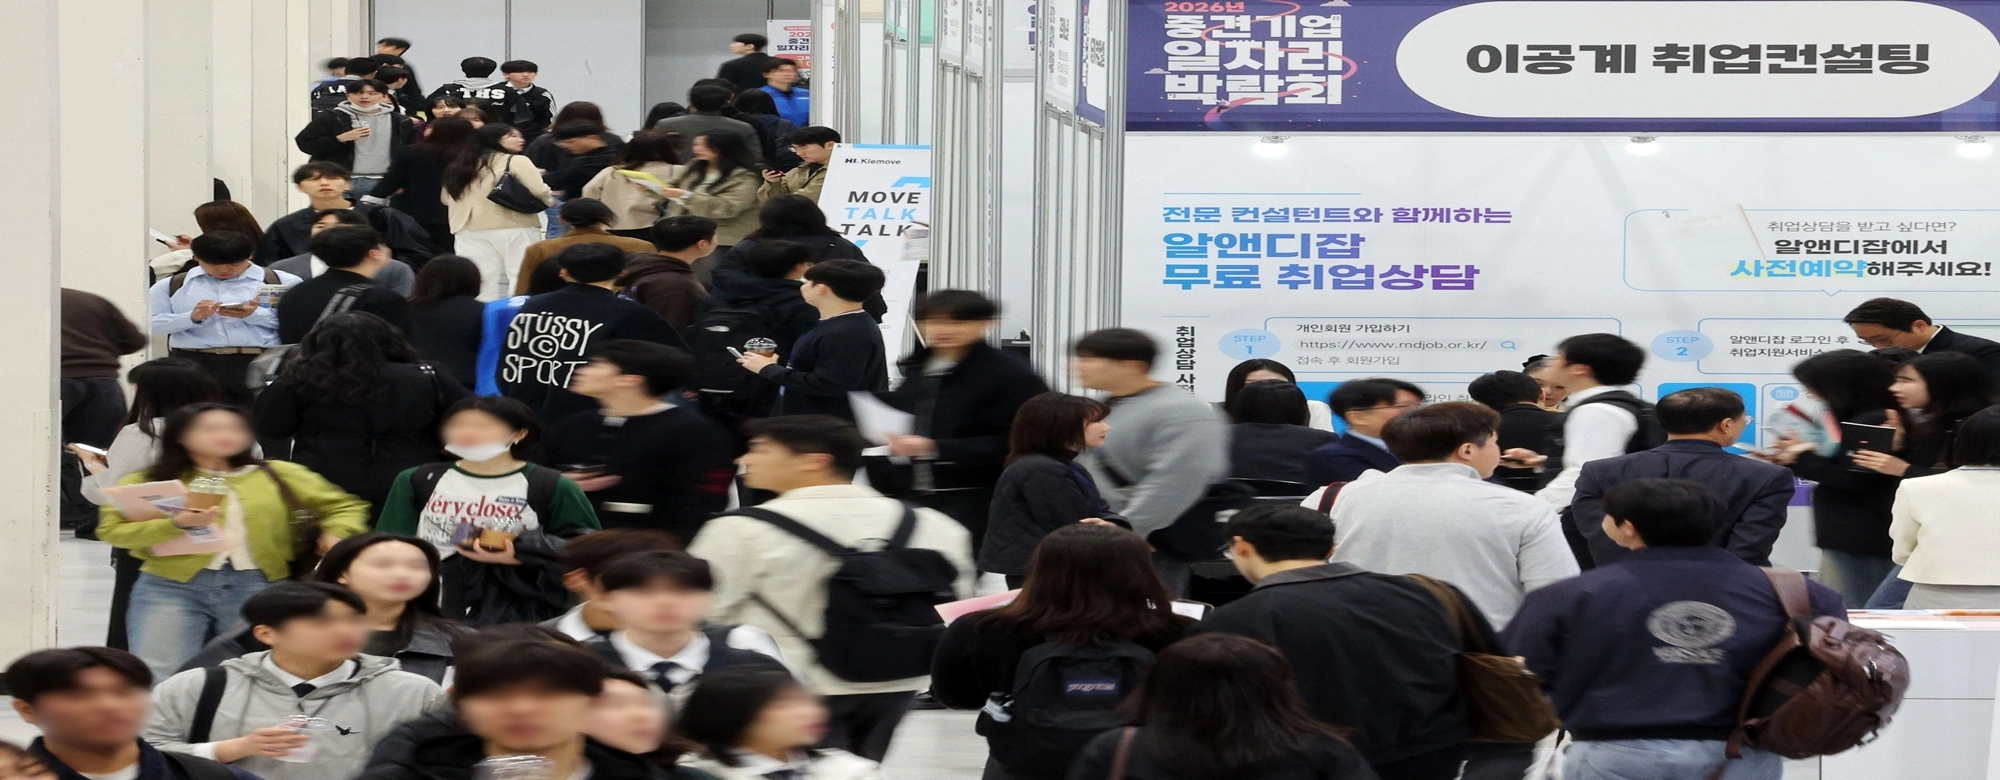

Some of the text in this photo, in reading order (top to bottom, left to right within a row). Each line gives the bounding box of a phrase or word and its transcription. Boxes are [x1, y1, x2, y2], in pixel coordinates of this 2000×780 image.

[1164, 2, 1244, 13] 2026년
[1164, 15, 1342, 38] 중견기업
[1163, 40, 1343, 72] 일자리
[1466, 43, 1930, 75] 이공계 취업컨설팅
[1164, 74, 1343, 105] 박람회
[847, 191, 922, 204] MOVE
[844, 207, 917, 220] TALK
[1162, 206, 1513, 224] 전문 컨설턴트와 함께하는
[840, 223, 913, 237] TALK
[1767, 221, 1957, 233] 취업상담을 받고 싶다면?
[1162, 232, 1366, 259] 알앤디잡
[1774, 239, 1948, 255] 알앤디잡에서
[1730, 259, 1992, 278] 사전예약해주세요!
[1162, 263, 1481, 291] 무료 취업상담
[507, 311, 604, 356] STÜSSY
[1296, 323, 1410, 333] 개인회원 가입하기
[1233, 334, 1267, 343] STEP
[1666, 336, 1700, 344] STEP
[1729, 335, 1786, 345] 알앤디잡
[1789, 335, 1831, 345] 로그인
[1835, 335, 1850, 345] 후
[1175, 325, 1197, 371] 취업상담
[1245, 345, 1254, 355] 1
[1676, 347, 1689, 356] 2
[1296, 356, 1400, 365] 접속 후 회원가입
[503, 354, 588, 389] SPORT
